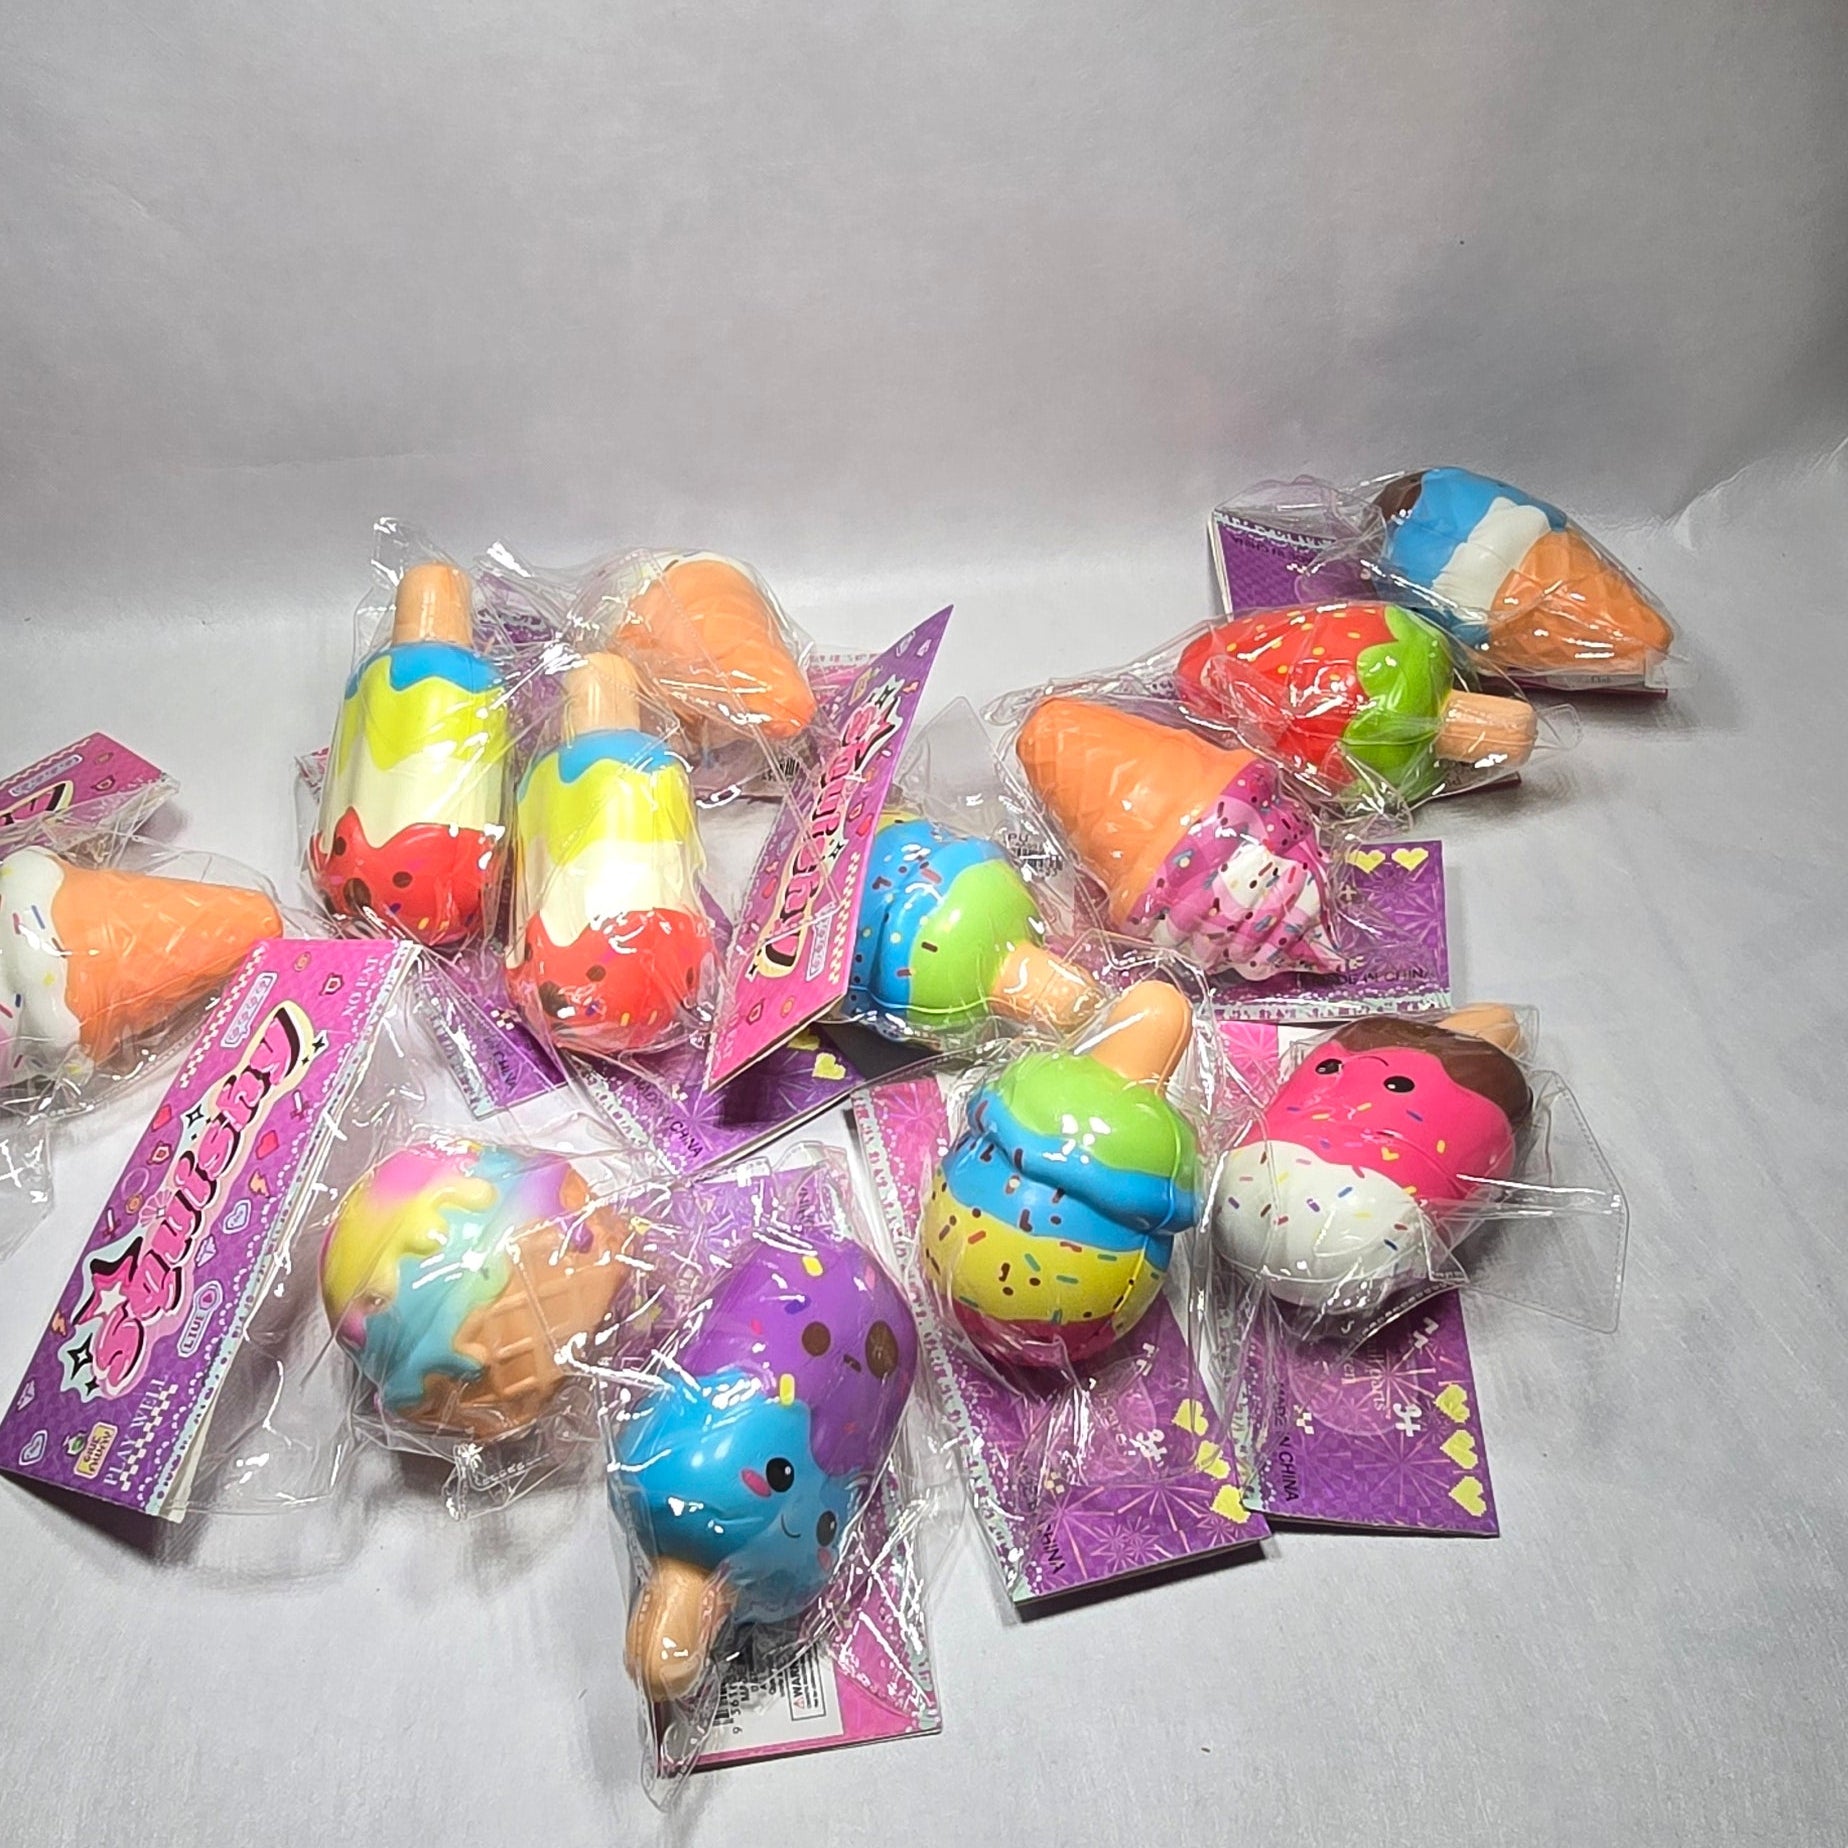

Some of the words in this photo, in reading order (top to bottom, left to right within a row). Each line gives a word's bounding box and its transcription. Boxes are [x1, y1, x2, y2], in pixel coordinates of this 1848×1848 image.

[768, 704, 881, 967] Squishy
[669, 1121, 704, 1157] CHINA
[93, 1005, 302, 1389] Squishy
[103, 1434, 137, 1486] PLAY
[130, 1375, 169, 1428] WELL
[1279, 1451, 1299, 1501] CHINA
